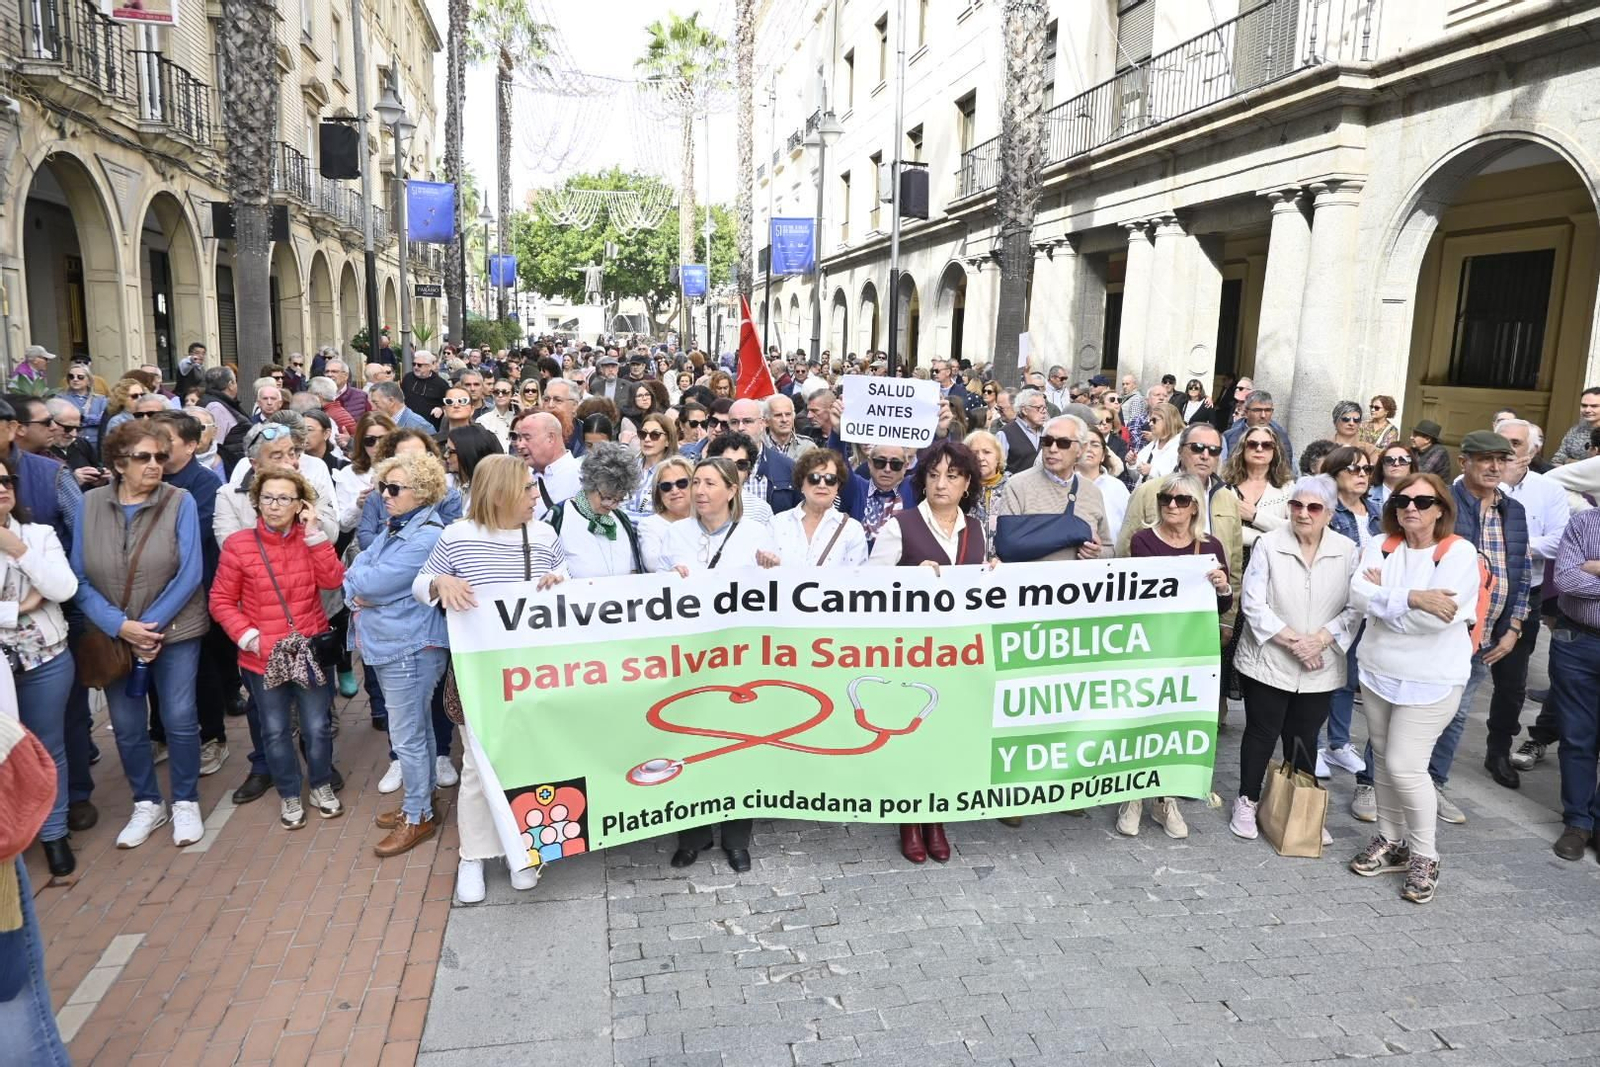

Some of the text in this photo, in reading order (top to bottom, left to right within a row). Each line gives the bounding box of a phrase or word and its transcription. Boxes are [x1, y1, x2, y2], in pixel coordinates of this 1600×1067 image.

[866, 403, 913, 419] ANTES
[868, 382, 915, 398] SALUD
[845, 422, 930, 441] QUE DINERO
[494, 571, 1179, 631] Valverde del Camino se moviliza
[1001, 623, 1151, 663] PÚBLICA
[504, 634, 984, 700] para salvar la Sanidad
[1003, 675, 1198, 718] UNIVERSAL
[998, 730, 1210, 772] Y DE CALIDAD
[602, 770, 1161, 837] Plataforma ciudadana por la SANIDAD PÚBLICA
